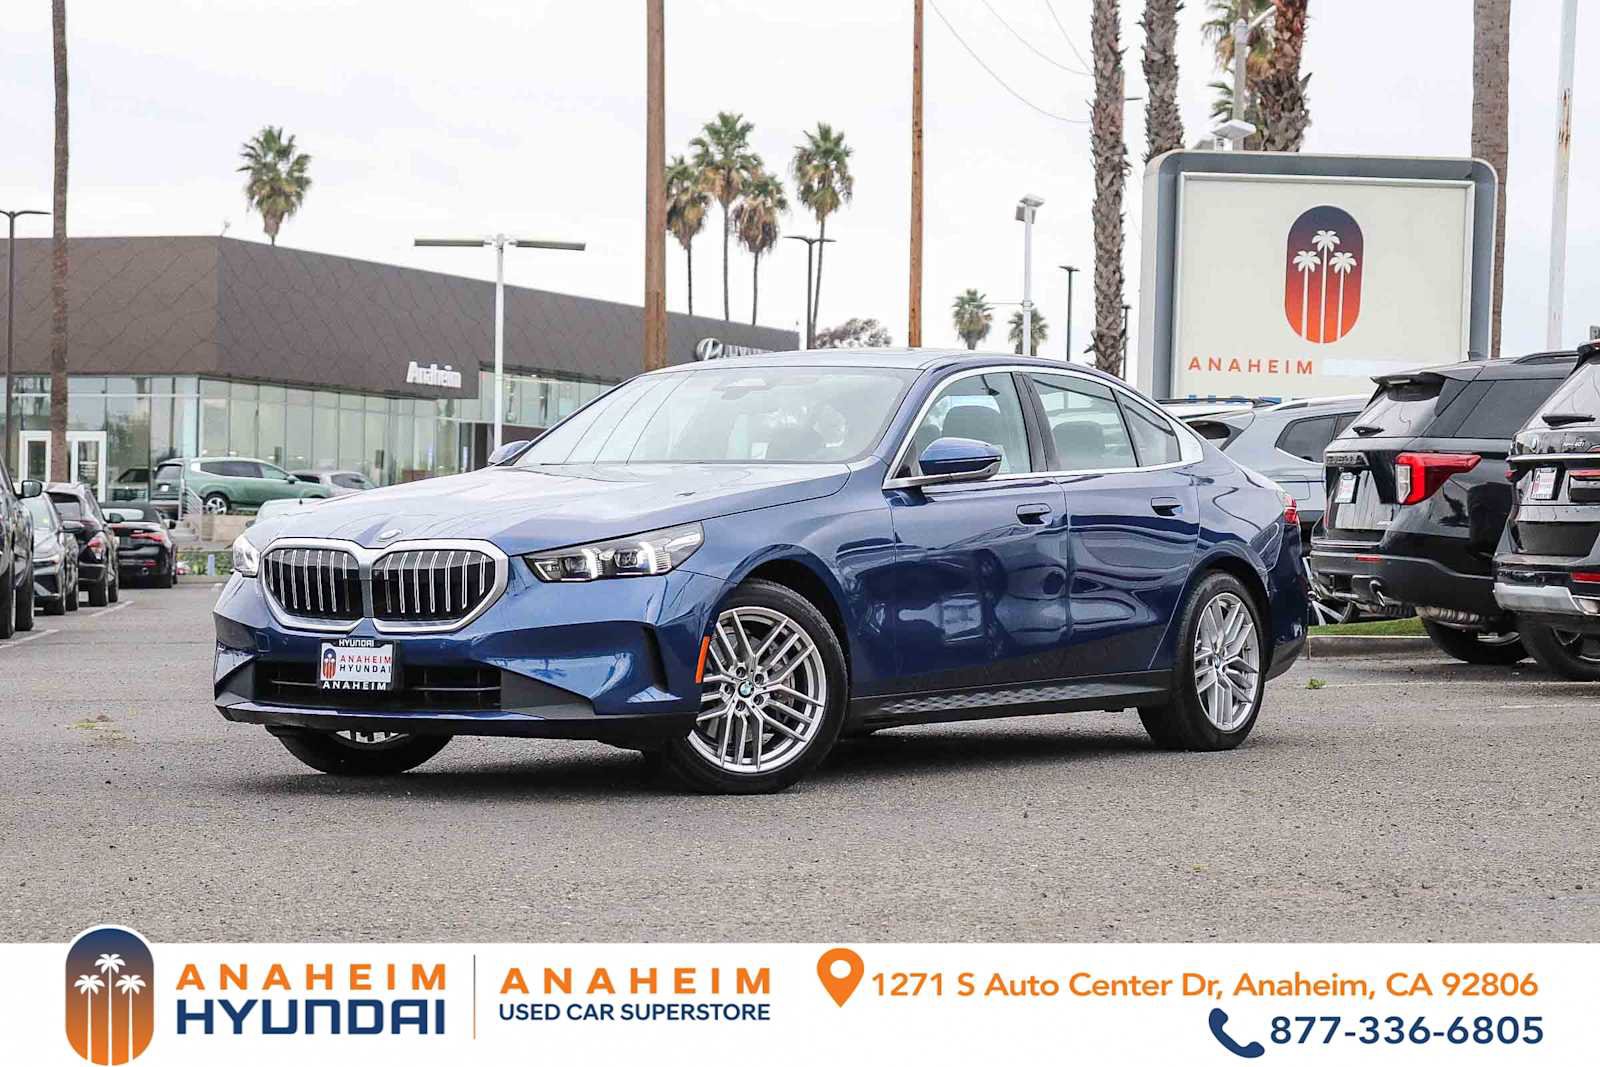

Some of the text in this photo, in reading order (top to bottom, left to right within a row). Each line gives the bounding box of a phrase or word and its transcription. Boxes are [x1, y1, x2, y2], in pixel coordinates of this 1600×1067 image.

[1188, 356, 1313, 375] ANAHEIM
[338, 639, 375, 647] HYUNDAI
[340, 655, 392, 664] ANAHEIM
[339, 664, 391, 673] HYUNDAI
[322, 681, 387, 690] ANAHEIM
